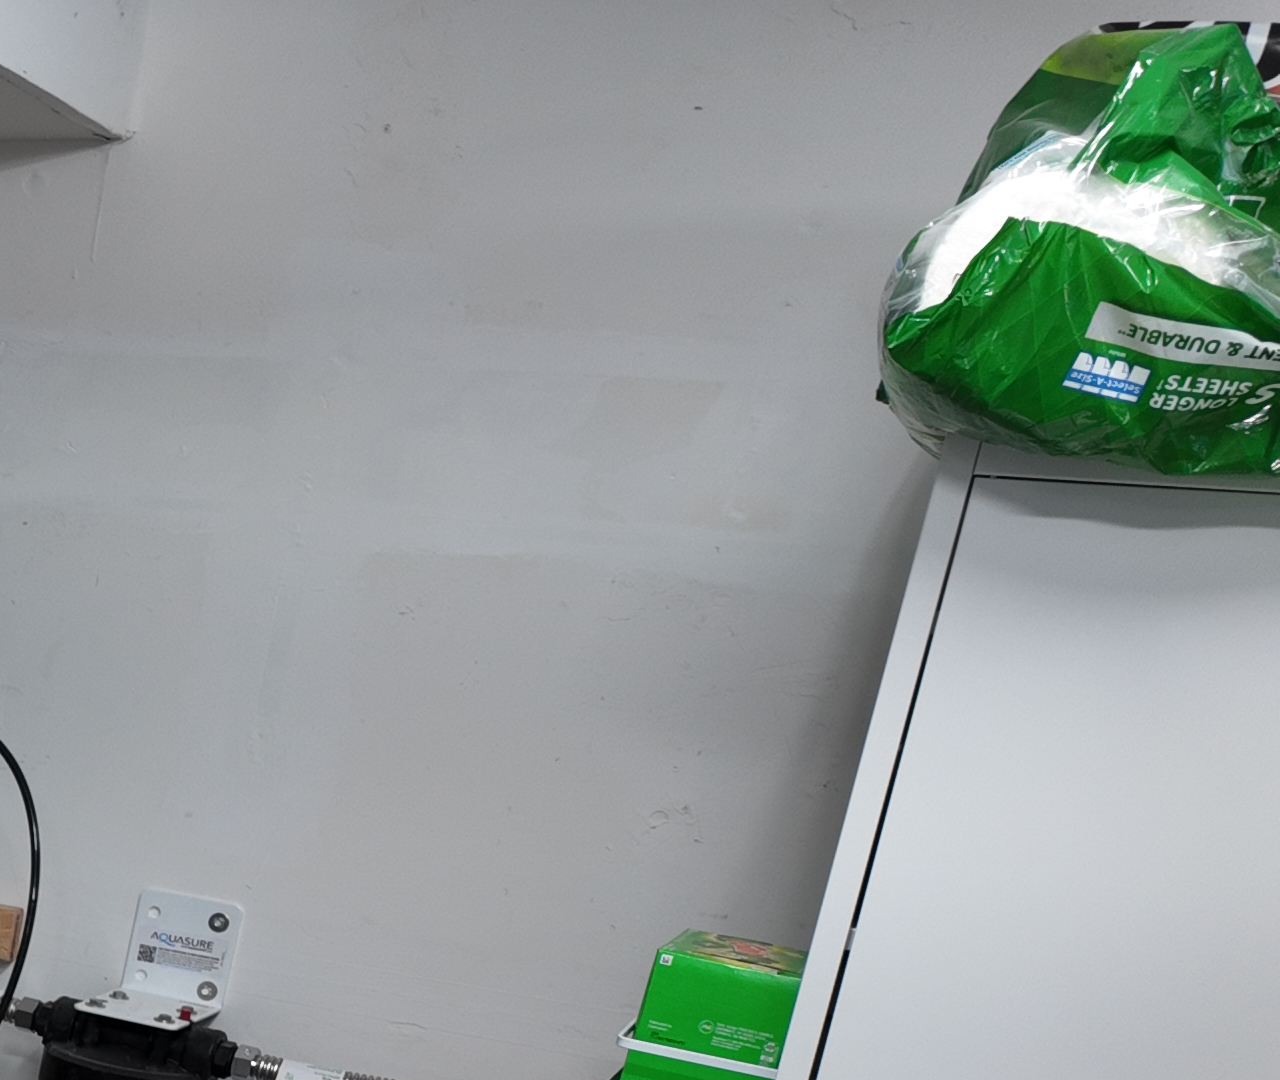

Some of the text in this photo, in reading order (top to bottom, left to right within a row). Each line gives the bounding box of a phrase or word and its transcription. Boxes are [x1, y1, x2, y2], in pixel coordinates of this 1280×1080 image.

[1226, 342, 1243, 356] &
[1070, 371, 1141, 394] Select-A-Size
[1149, 392, 1239, 411] LONGER
[150, 932, 214, 950] AQUASURE
